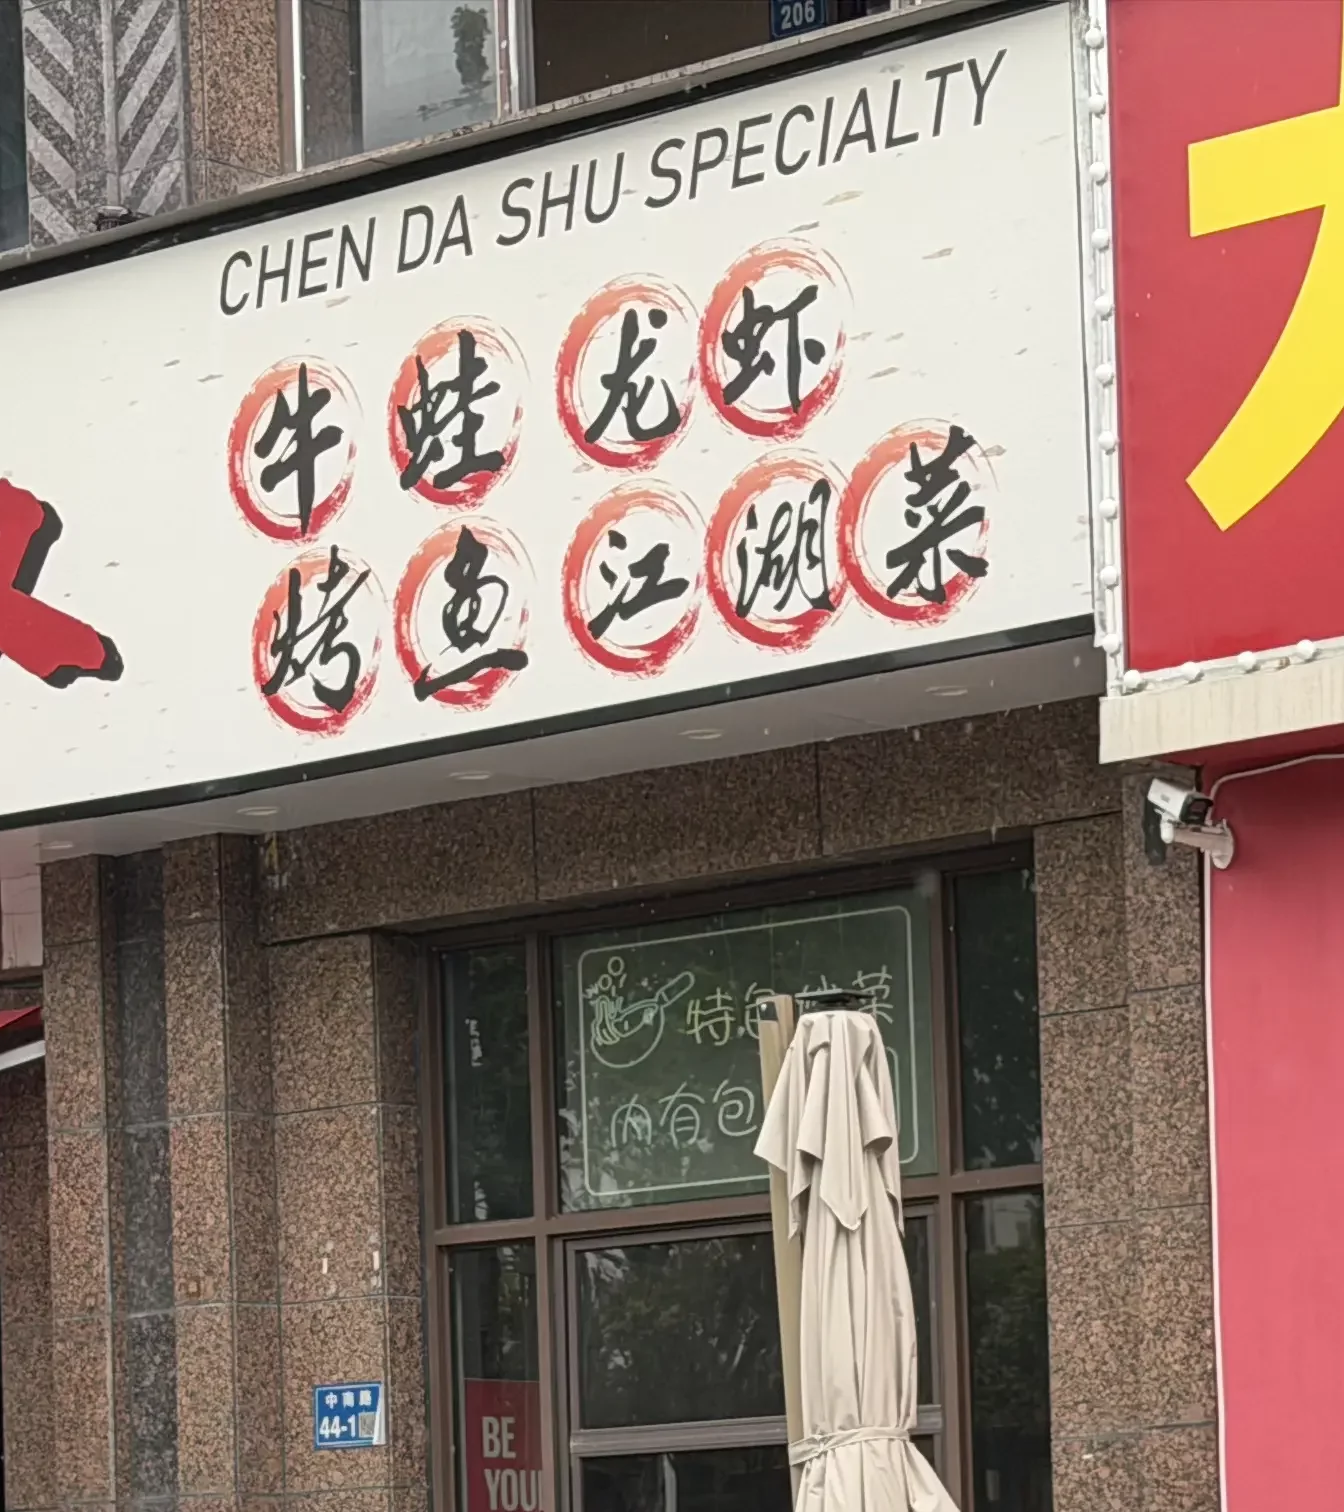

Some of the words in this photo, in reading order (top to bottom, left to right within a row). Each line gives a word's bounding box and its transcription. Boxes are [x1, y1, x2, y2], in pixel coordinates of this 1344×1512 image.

[781, 0, 816, 30] 206
[219, 217, 377, 317] CHEN
[397, 194, 474, 275] DA
[496, 151, 626, 247] SHU
[644, 48, 1009, 208] SPECIALTY
[255, 331, 507, 535] 牛蛙
[587, 284, 826, 444] 龙虾
[263, 526, 530, 713] 烤鱼
[589, 426, 990, 641] 江湖菜
[319, 1414, 356, 1439] 44-1
[481, 1415, 516, 1459] BE
